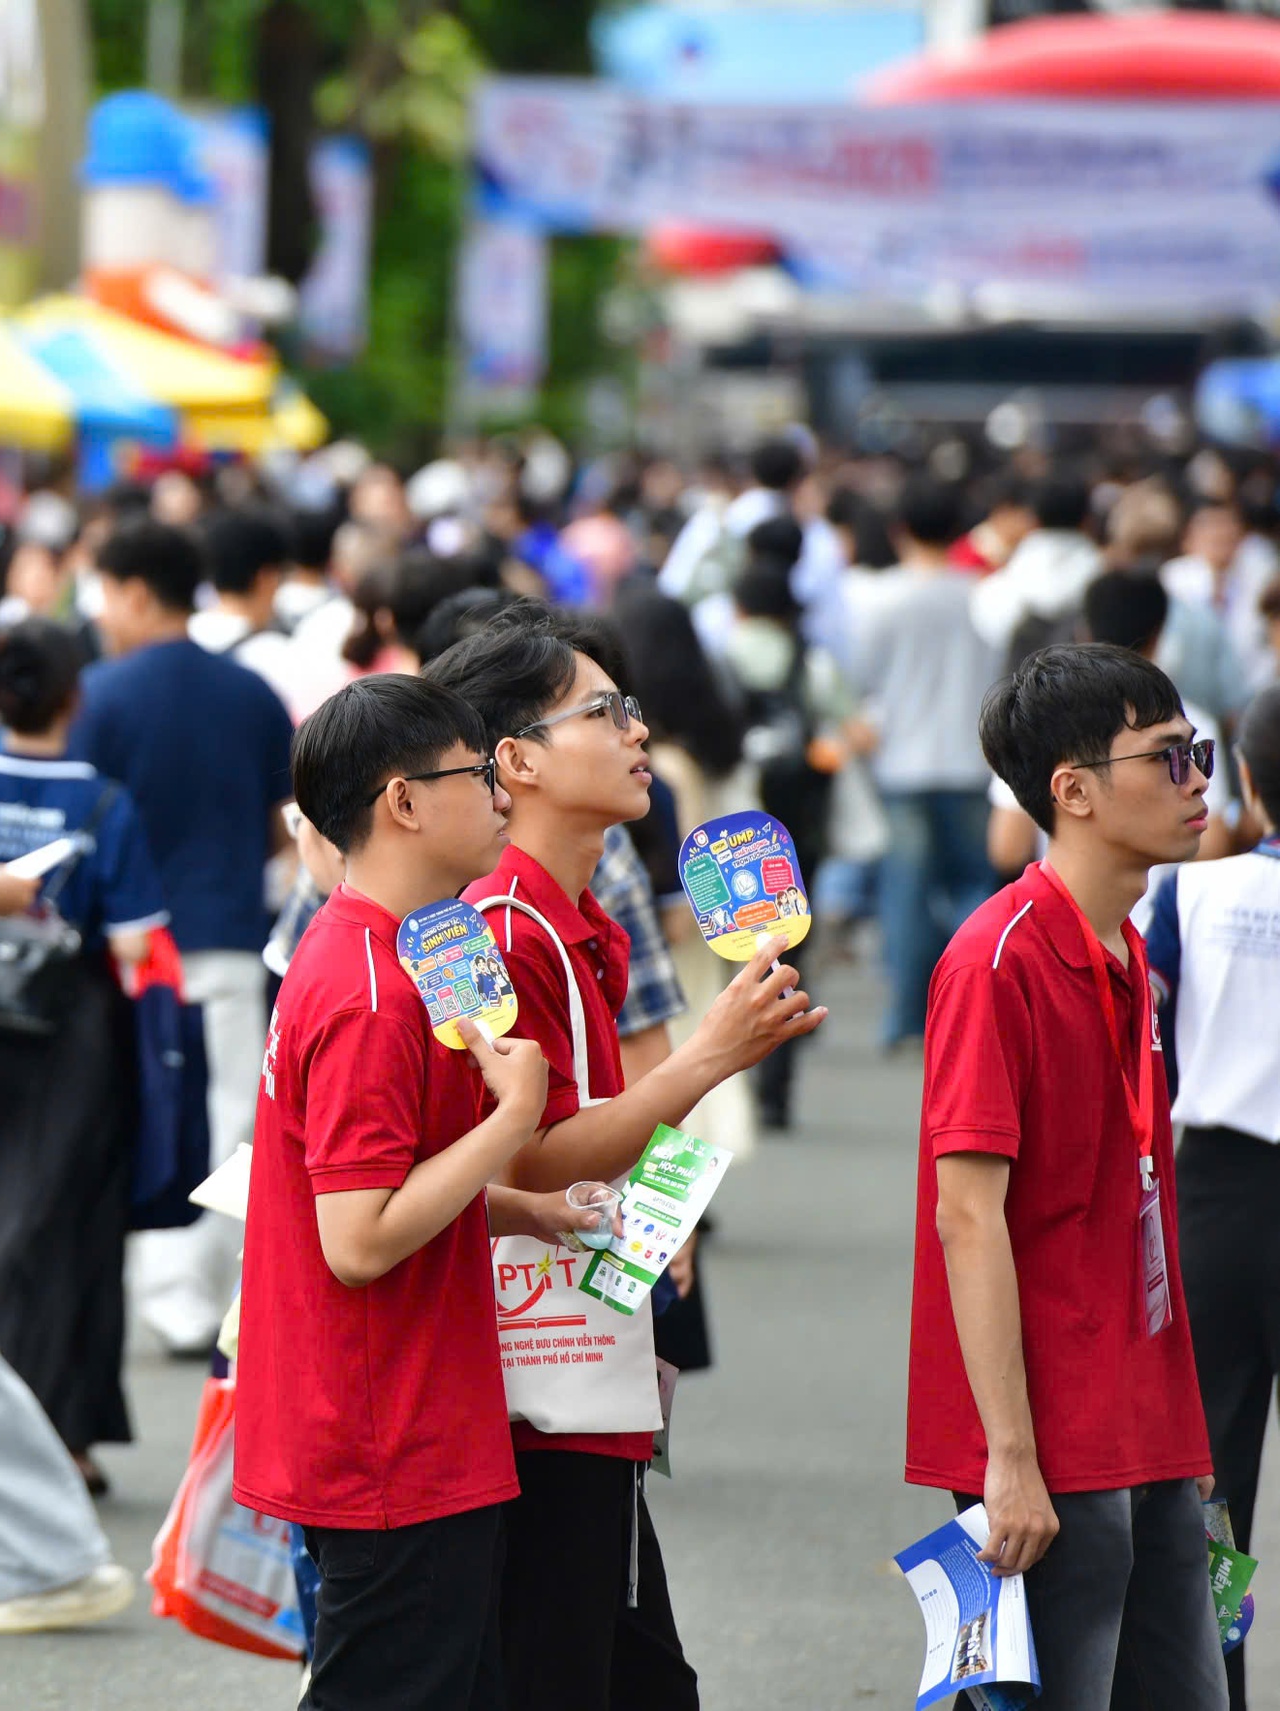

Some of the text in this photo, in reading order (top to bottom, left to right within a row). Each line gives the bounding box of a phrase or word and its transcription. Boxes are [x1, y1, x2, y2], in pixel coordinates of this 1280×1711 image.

[729, 830, 754, 848] UMP
[422, 932, 444, 953] SINH
[514, 1337, 534, 1352] NGHỆ
[553, 1335, 574, 1348] CHÍNH
[576, 1333, 592, 1346] VIỄN
[594, 1334, 615, 1346] THÔNG
[502, 1358, 514, 1369] TẠI
[516, 1354, 541, 1366] THÀNH
[543, 1352, 558, 1365] PHỐ
[572, 1352, 584, 1363] CHÍ
[585, 1352, 603, 1362] MINH
[1212, 1556, 1233, 1595] MIỄN
